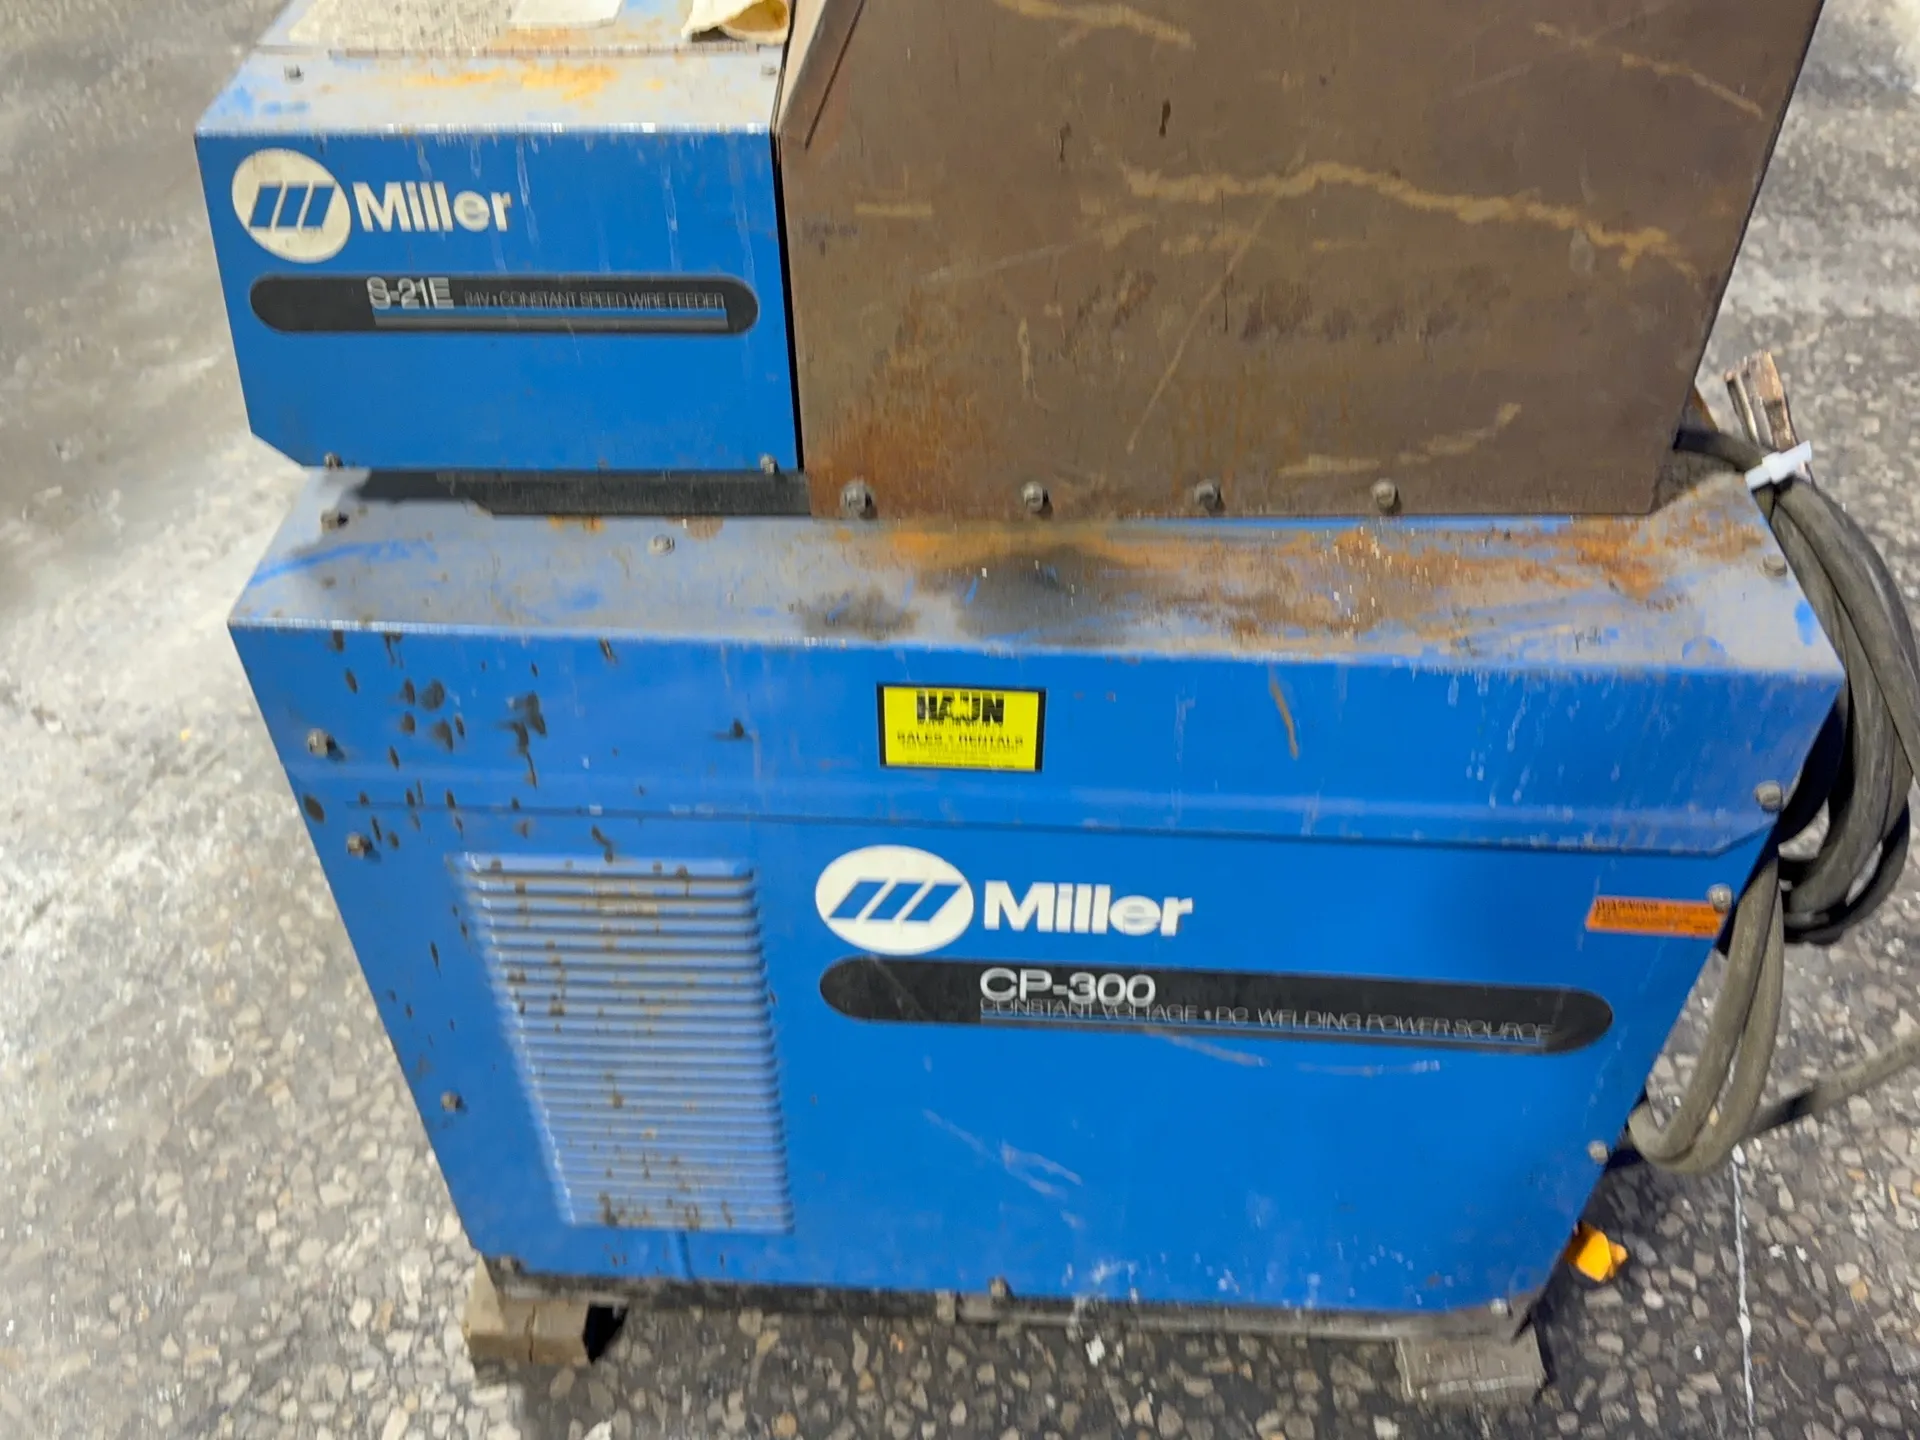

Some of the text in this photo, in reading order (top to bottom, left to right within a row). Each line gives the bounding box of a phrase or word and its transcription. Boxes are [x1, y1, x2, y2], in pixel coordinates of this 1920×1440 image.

[352, 181, 512, 232] Miller
[367, 276, 454, 310] S-21E
[500, 291, 577, 310] CONSTANT
[580, 291, 628, 311] SPEED
[629, 291, 667, 311] WIRE
[668, 291, 726, 311] FEEDER
[984, 879, 1193, 936] Miller
[980, 967, 1156, 1007] CP-300
[980, 998, 1093, 1019] CONSTANT
[1101, 1002, 1198, 1023] VOLTAGE
[1258, 1008, 1362, 1032] WELDING
[1366, 1013, 1449, 1037] POWER
[1453, 1018, 1556, 1043] SOURCE
